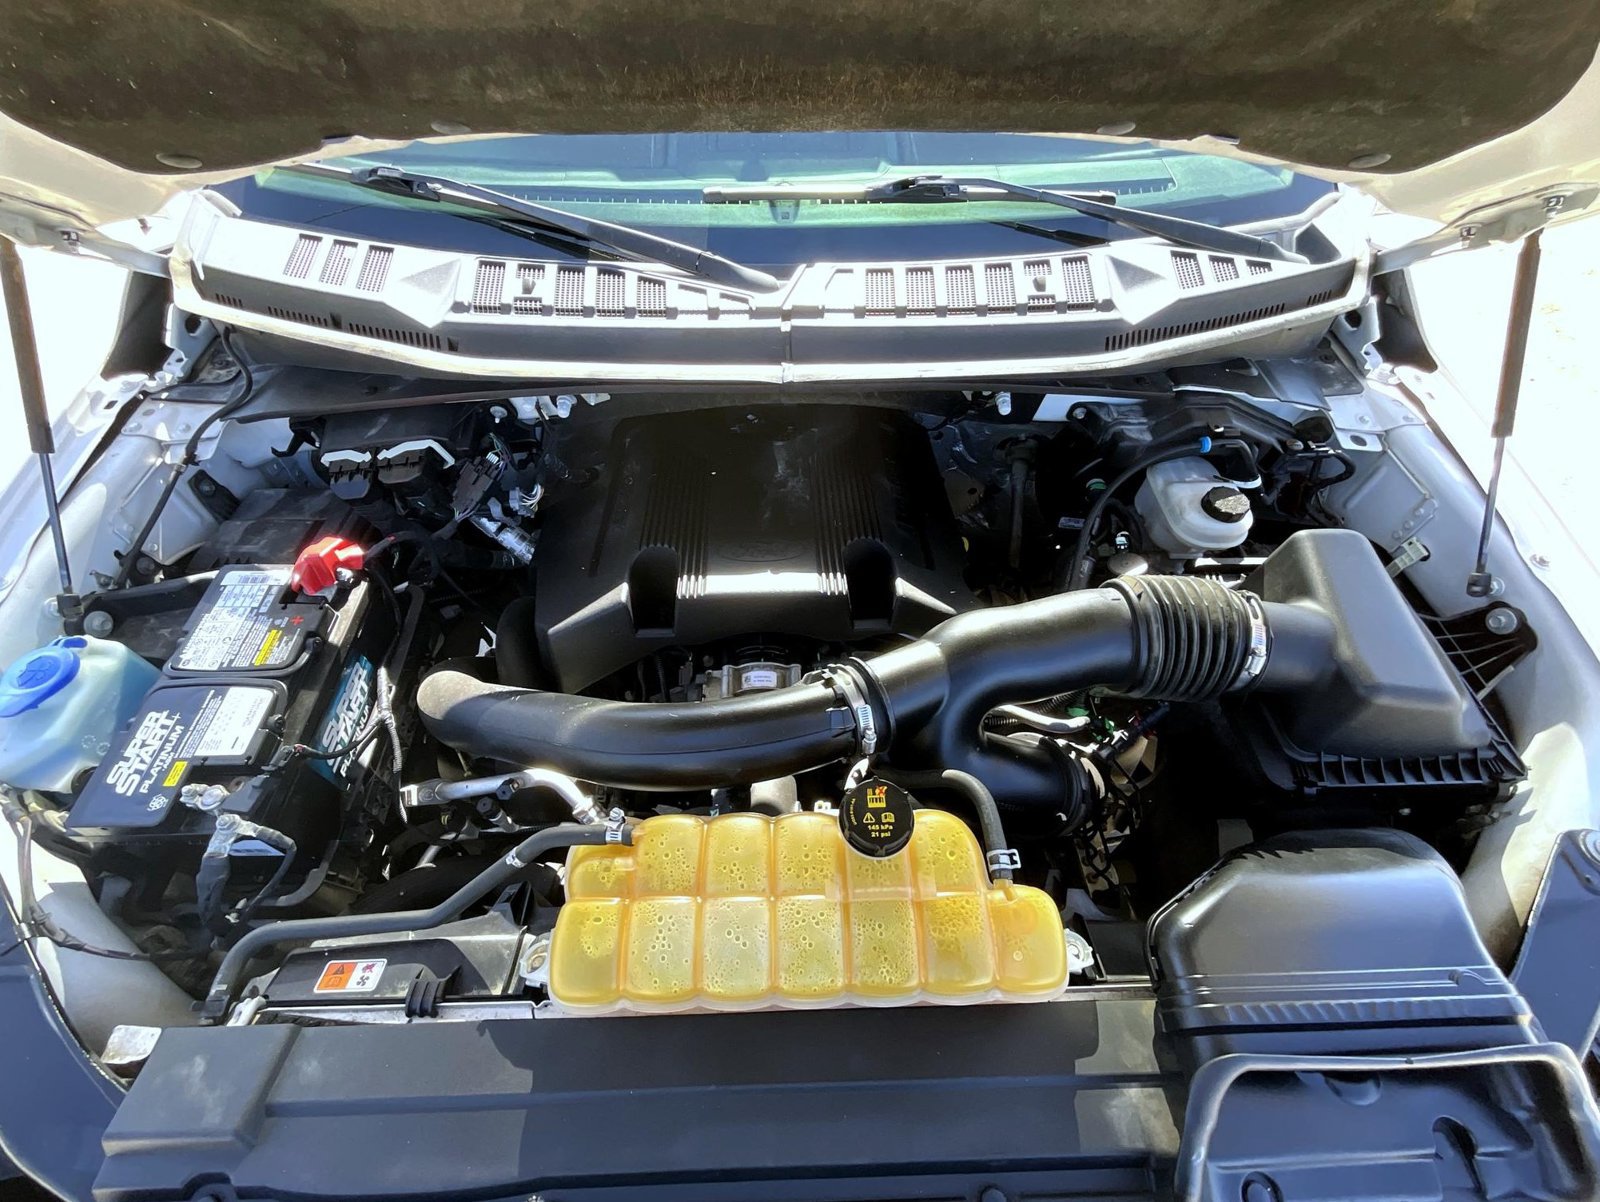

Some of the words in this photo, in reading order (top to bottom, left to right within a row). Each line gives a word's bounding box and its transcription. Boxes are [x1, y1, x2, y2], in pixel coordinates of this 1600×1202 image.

[106, 710, 163, 785] SUPER
[322, 661, 364, 748] SUPER
[326, 668, 369, 775] START
[115, 709, 171, 797] START
[139, 725, 185, 794] PLATINUM
